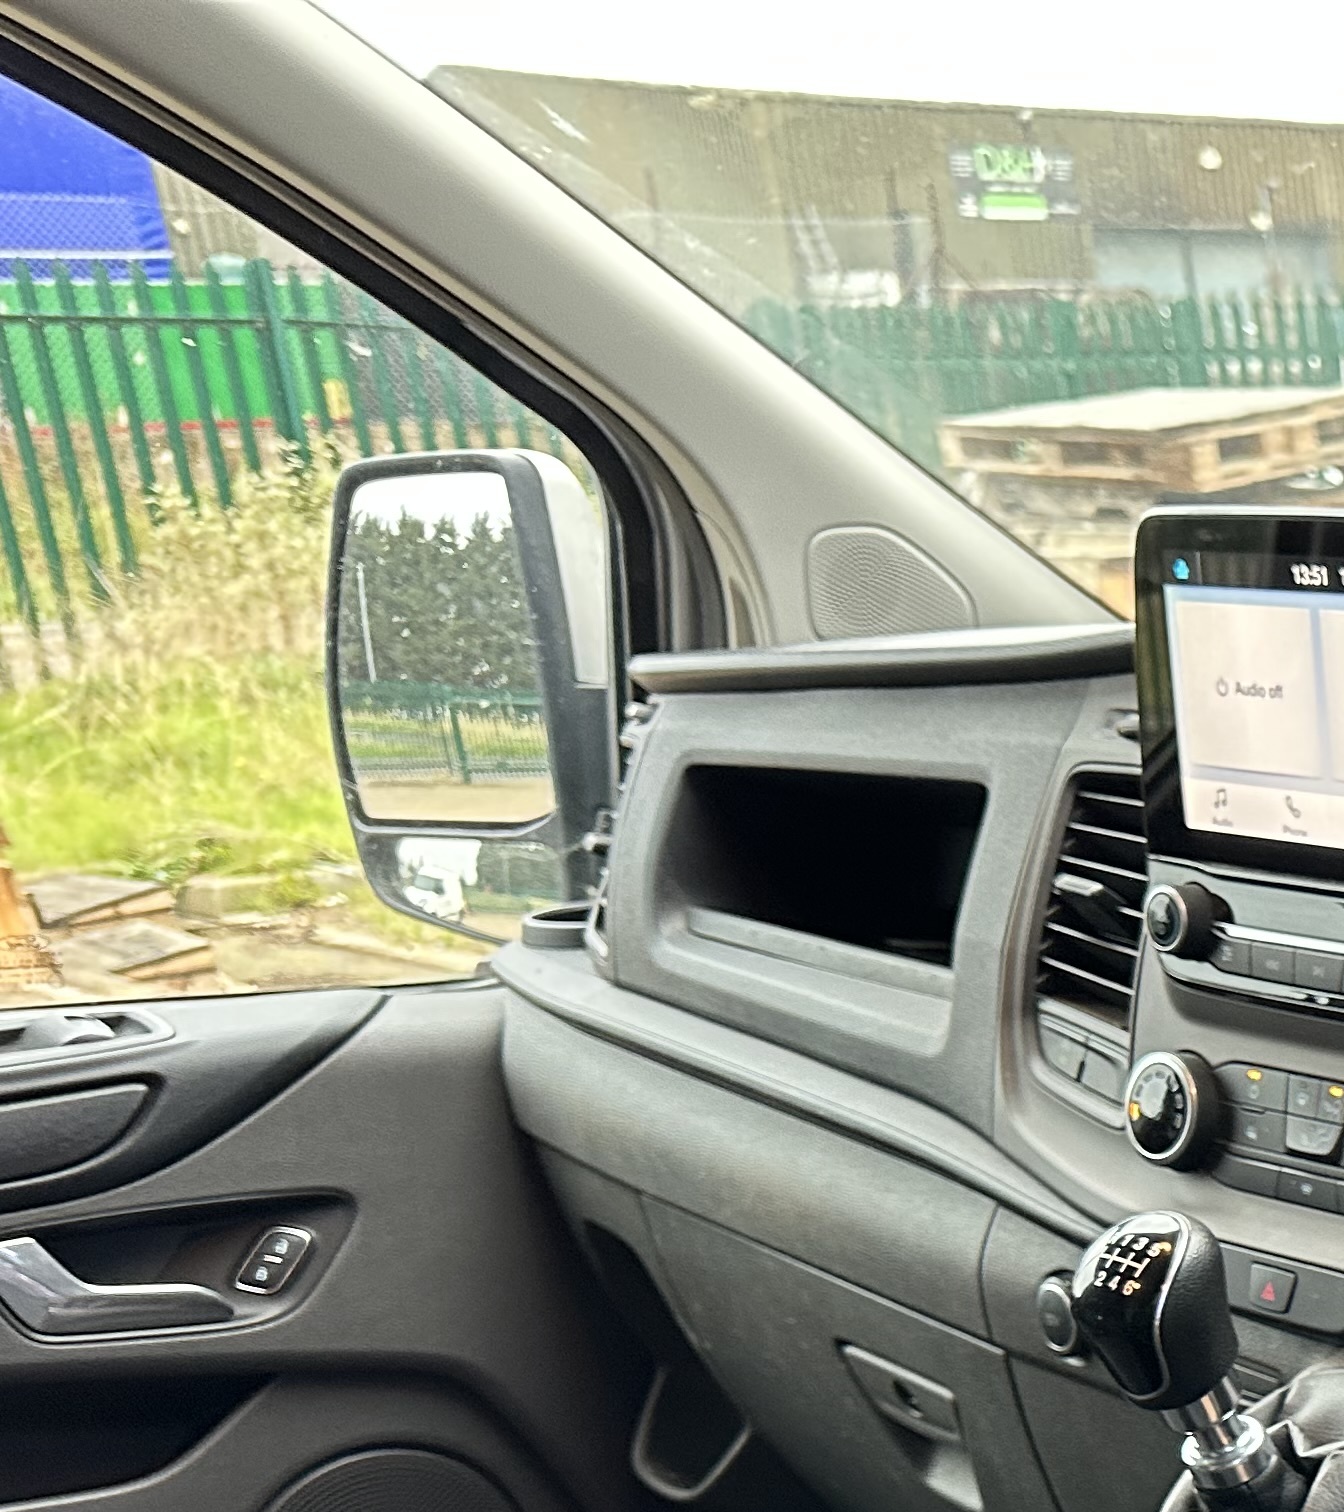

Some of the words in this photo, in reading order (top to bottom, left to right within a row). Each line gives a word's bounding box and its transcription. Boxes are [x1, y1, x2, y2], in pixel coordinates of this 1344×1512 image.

[1234, 681, 1266, 699] Audio
[1132, 1236, 1149, 1250] 3
[1094, 1271, 1107, 1287] 2
[1122, 1279, 1137, 1296] 6
